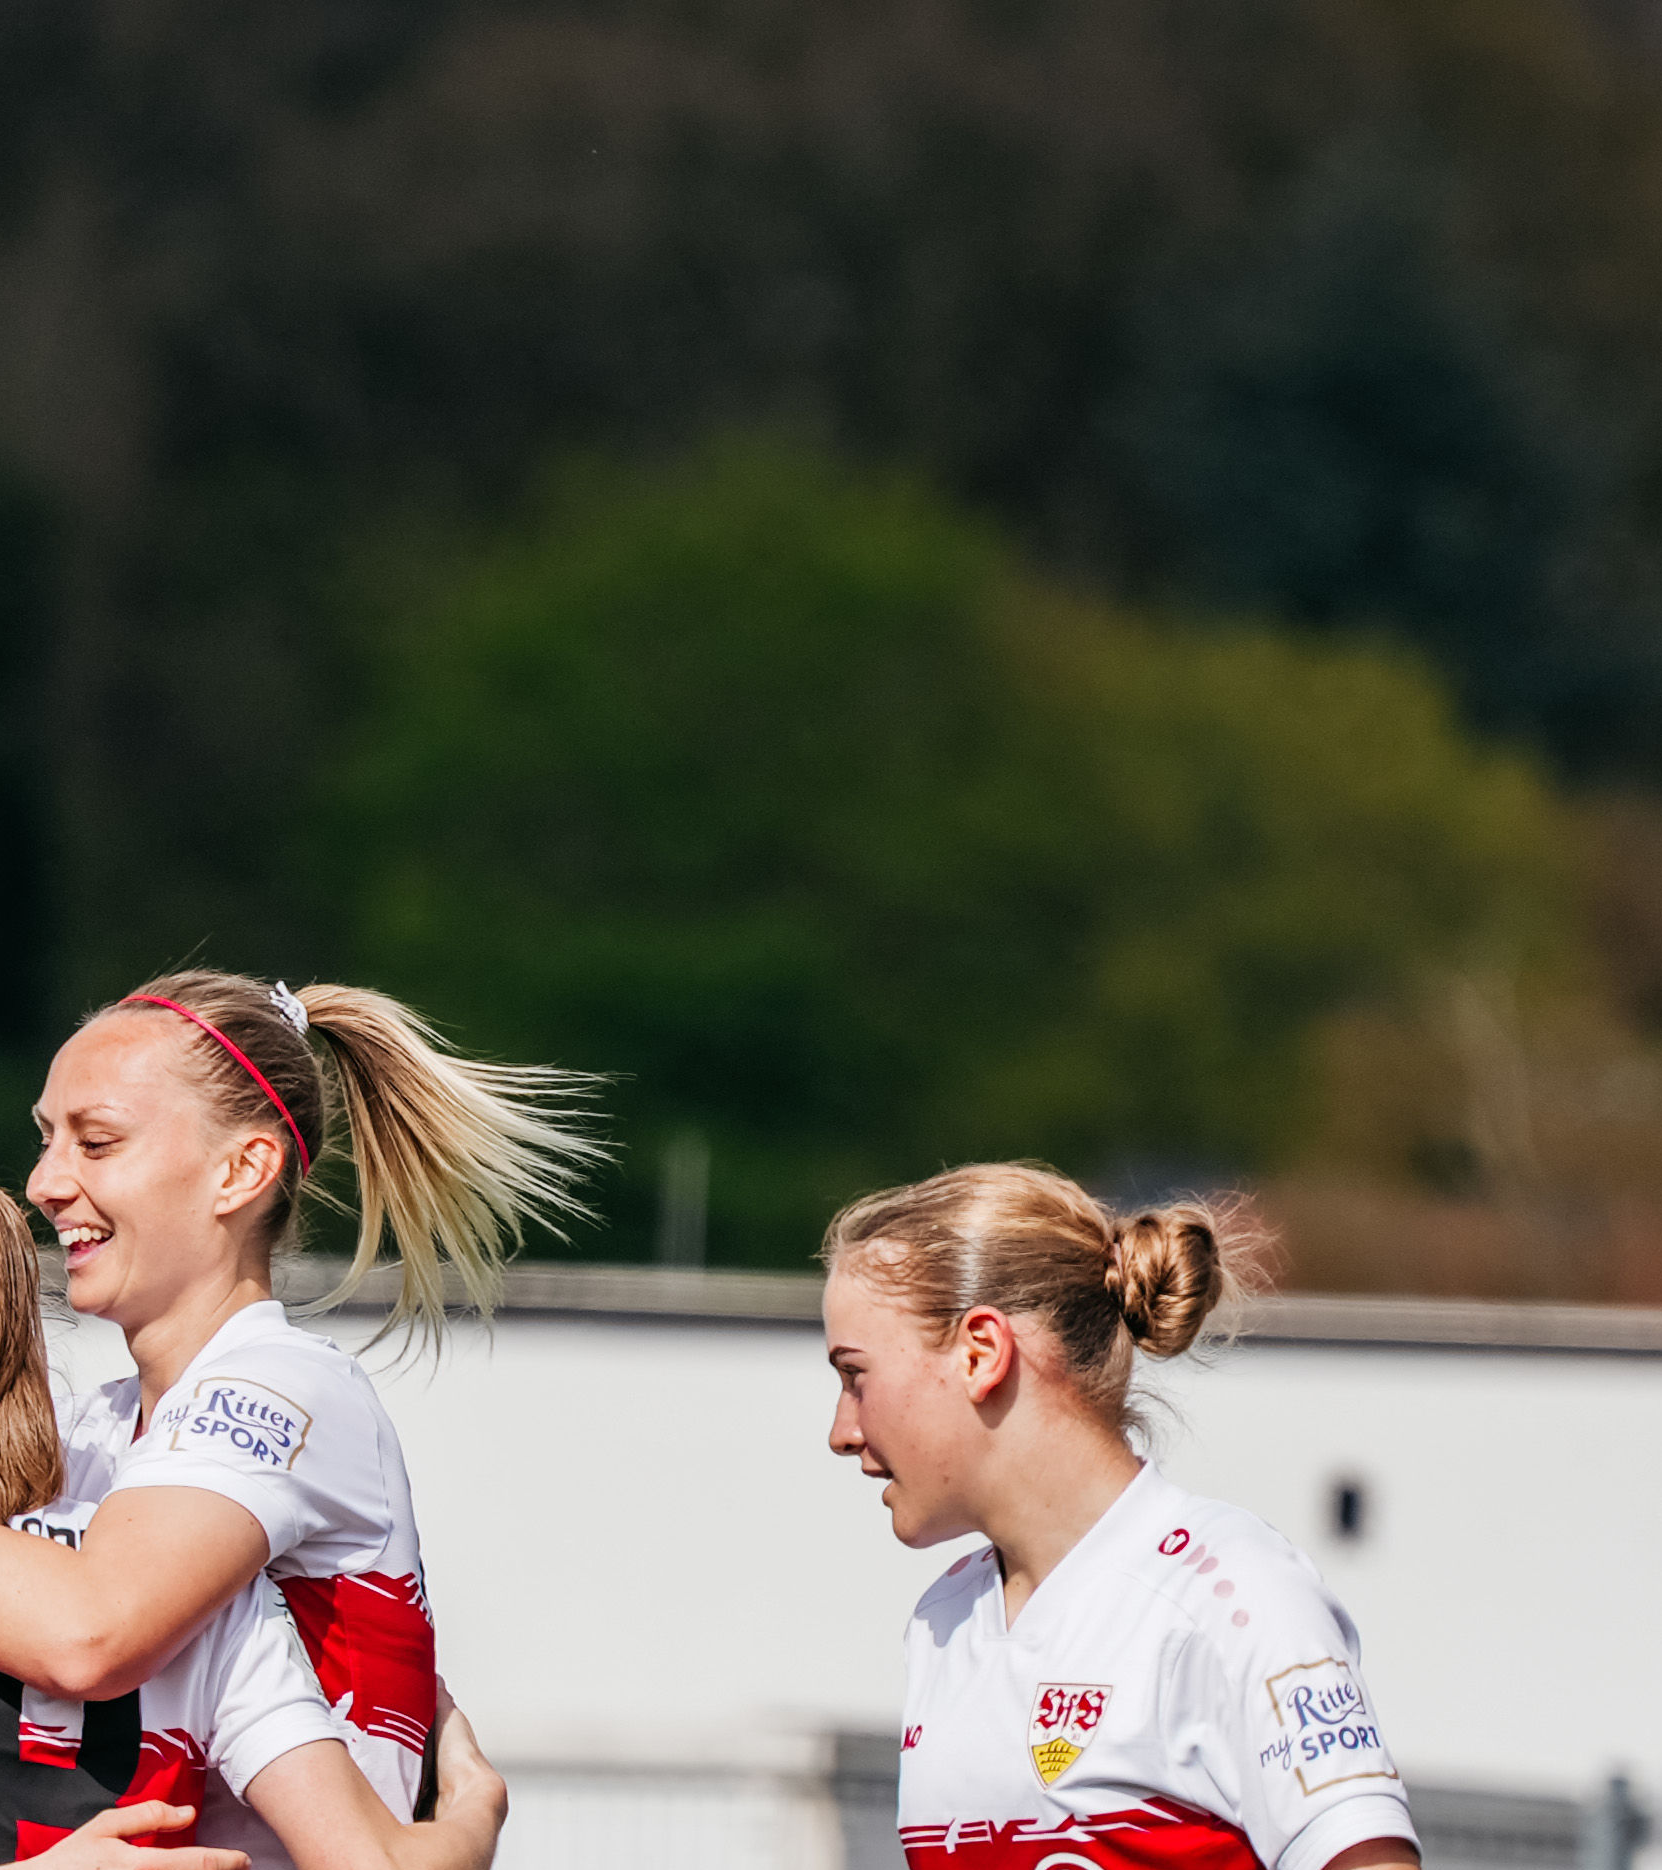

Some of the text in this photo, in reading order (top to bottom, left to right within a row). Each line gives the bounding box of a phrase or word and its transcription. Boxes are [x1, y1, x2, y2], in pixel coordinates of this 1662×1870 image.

[190, 1416, 282, 1466] SPORT
[201, 1387, 297, 1448] Ritter
[1286, 1682, 1367, 1734] Ritte
[1260, 1734, 1294, 1771] my
